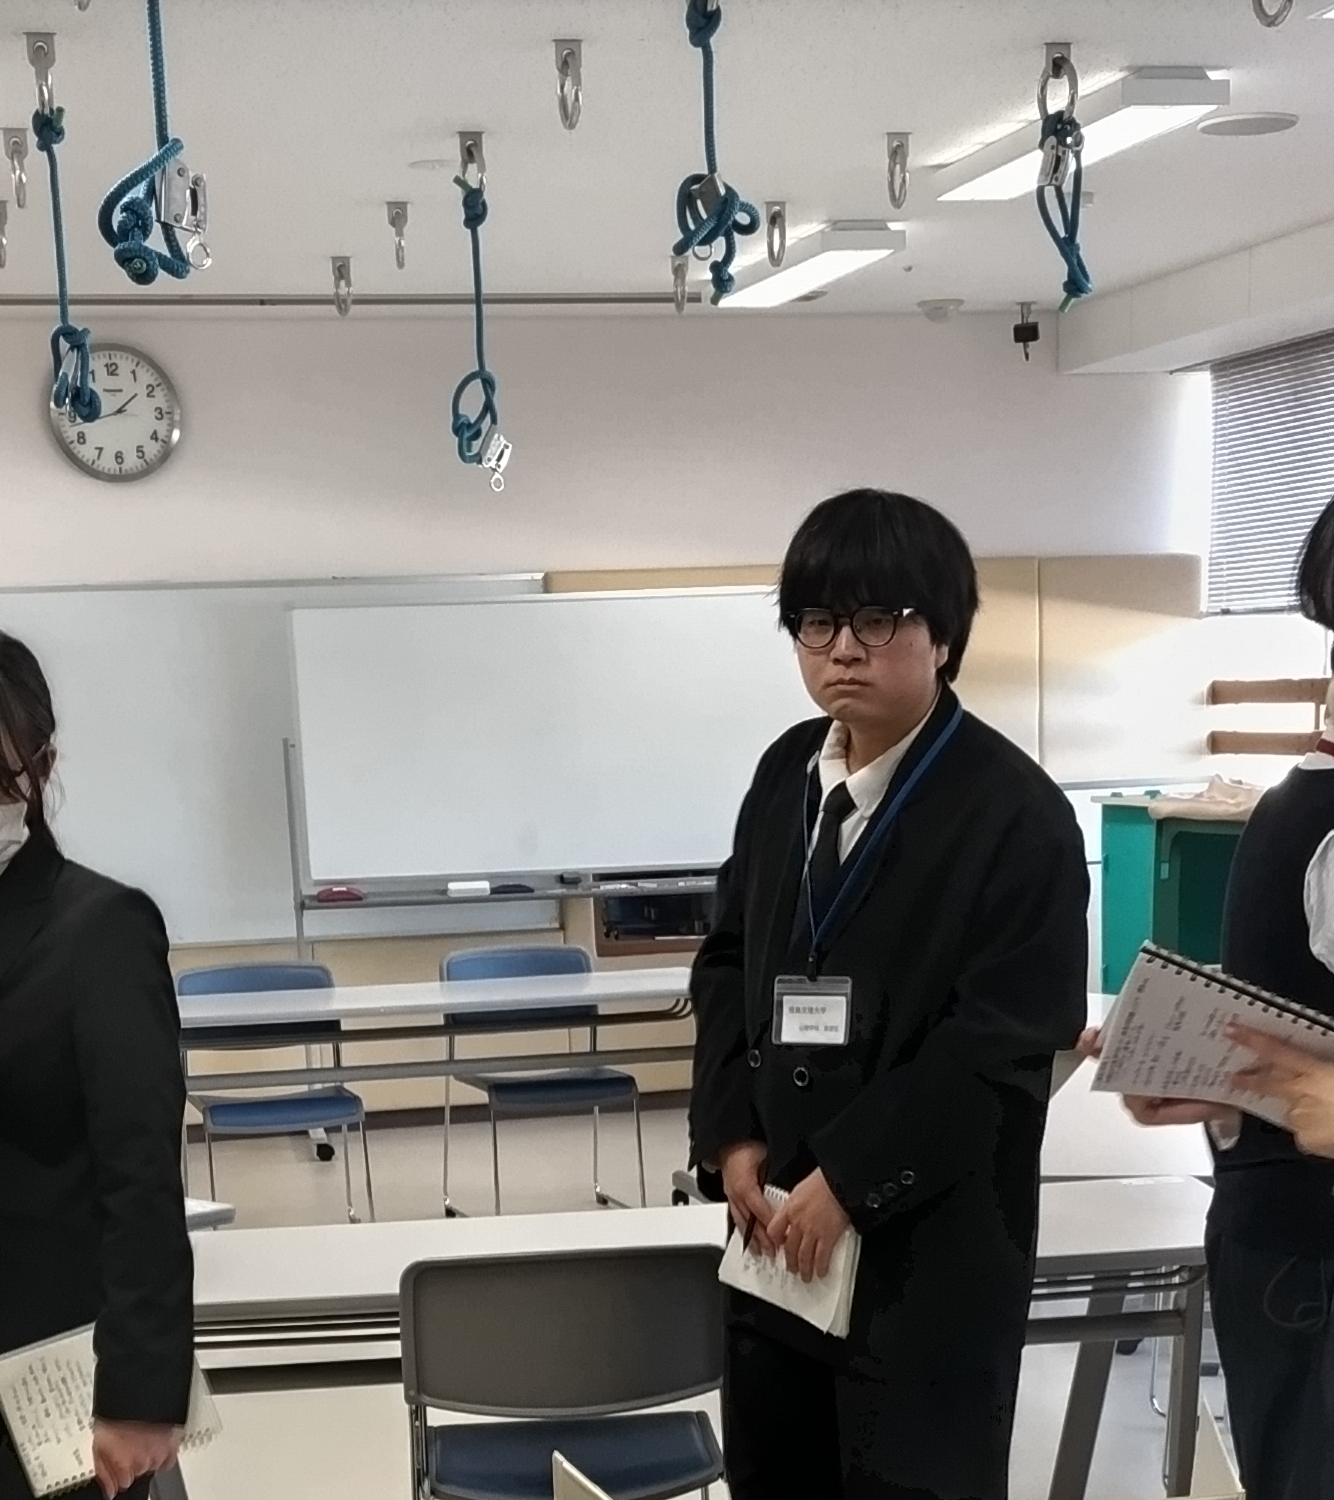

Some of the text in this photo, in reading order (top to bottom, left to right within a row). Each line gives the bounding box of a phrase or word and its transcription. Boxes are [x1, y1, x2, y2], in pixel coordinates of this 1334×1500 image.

[89, 369, 96, 381] 1
[104, 362, 119, 377] 12
[129, 370, 137, 382] 1
[146, 383, 155, 398] 2
[154, 407, 163, 421] 3
[76, 431, 86, 445] 8
[149, 430, 159, 442] 4
[93, 447, 104, 461] 7
[114, 450, 124, 465] 6
[136, 445, 145, 459] 5
